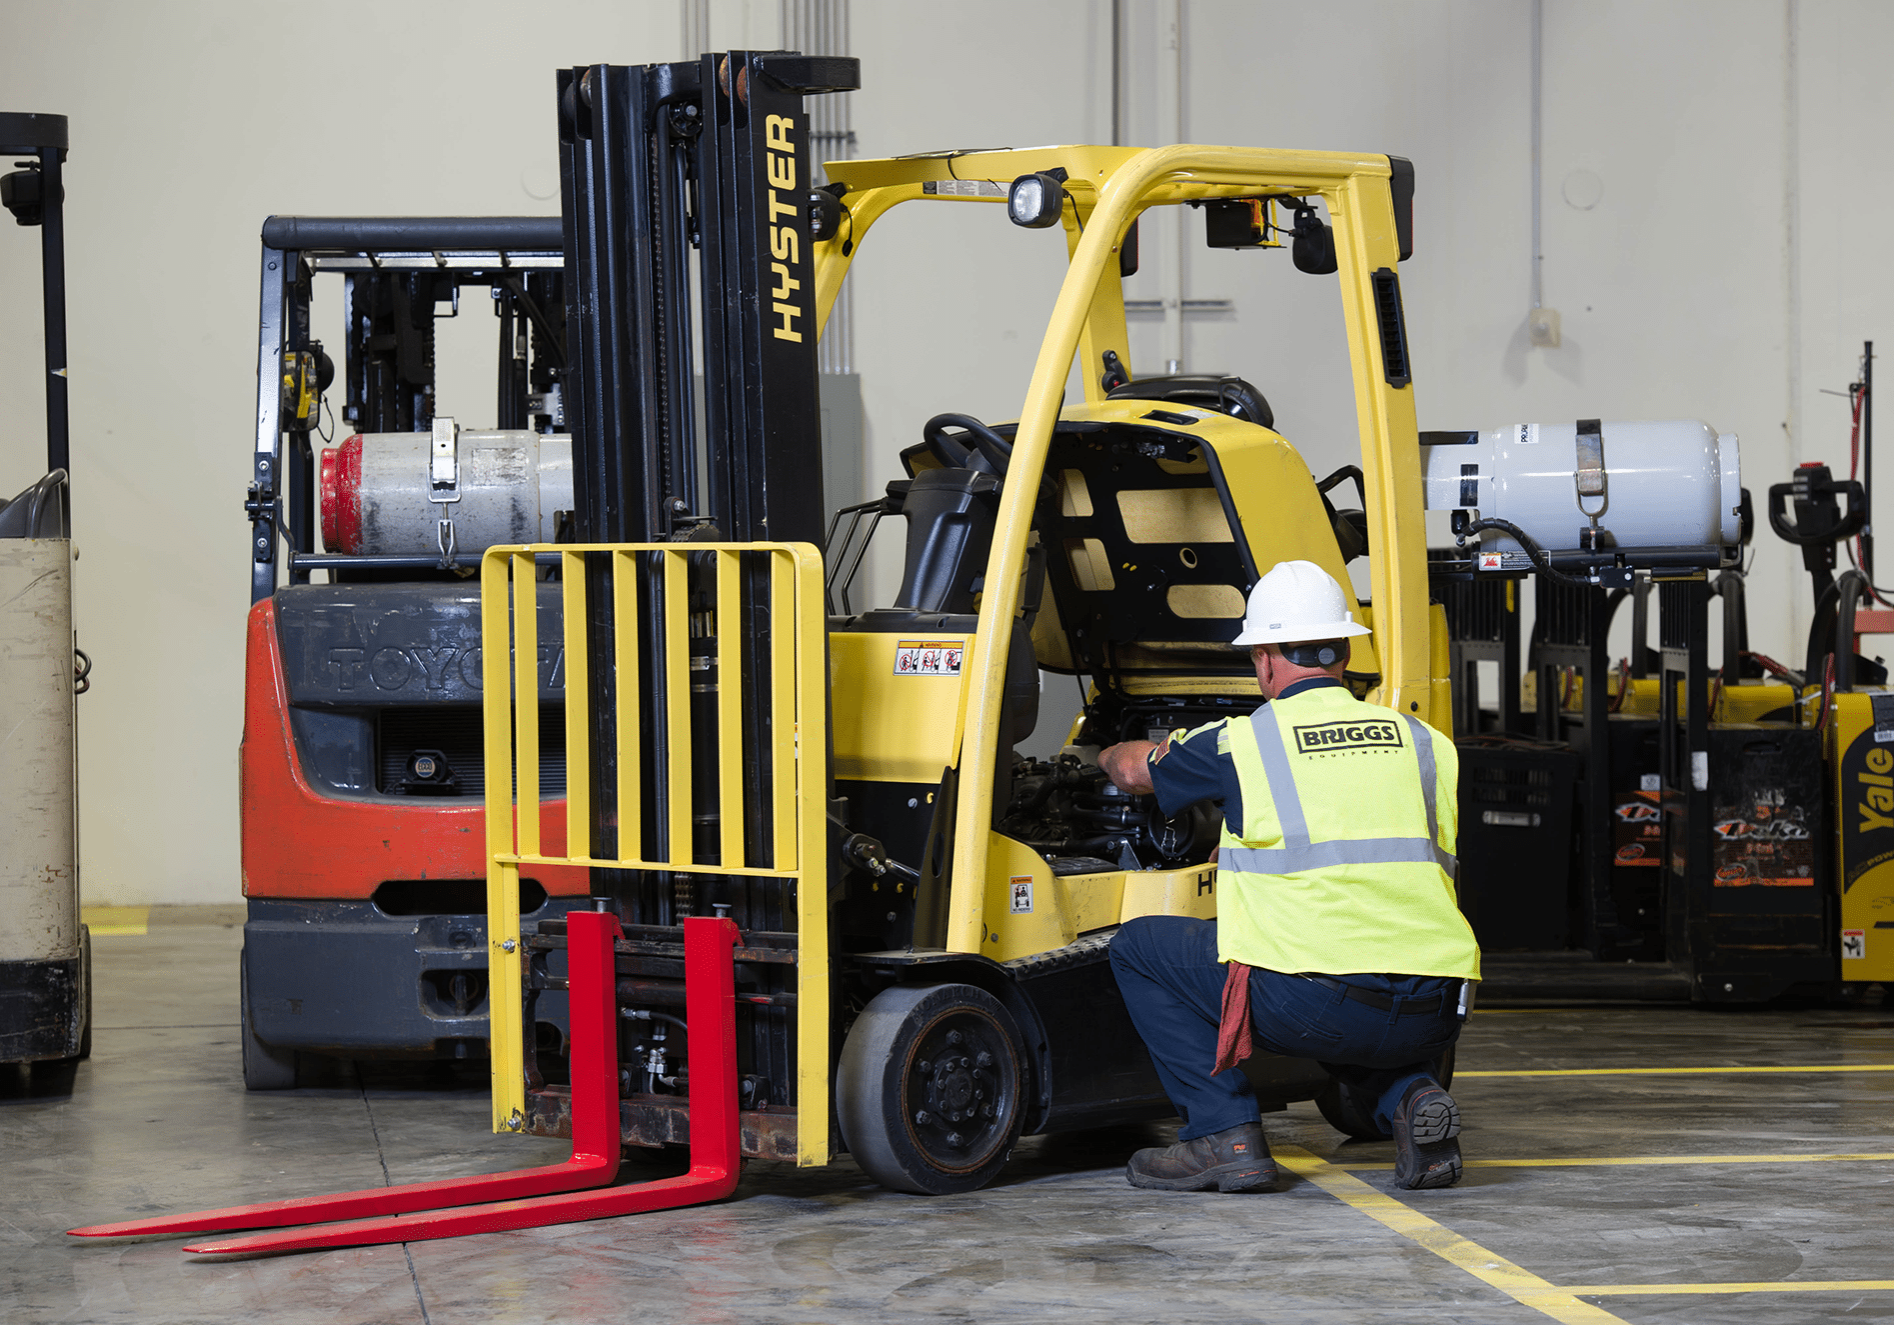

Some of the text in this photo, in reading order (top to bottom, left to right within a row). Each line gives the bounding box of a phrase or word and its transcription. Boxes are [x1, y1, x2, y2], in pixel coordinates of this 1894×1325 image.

[765, 114, 803, 344] HYSTER
[1303, 725, 1395, 746] BRIGGS
[1858, 748, 1894, 833] Yale
